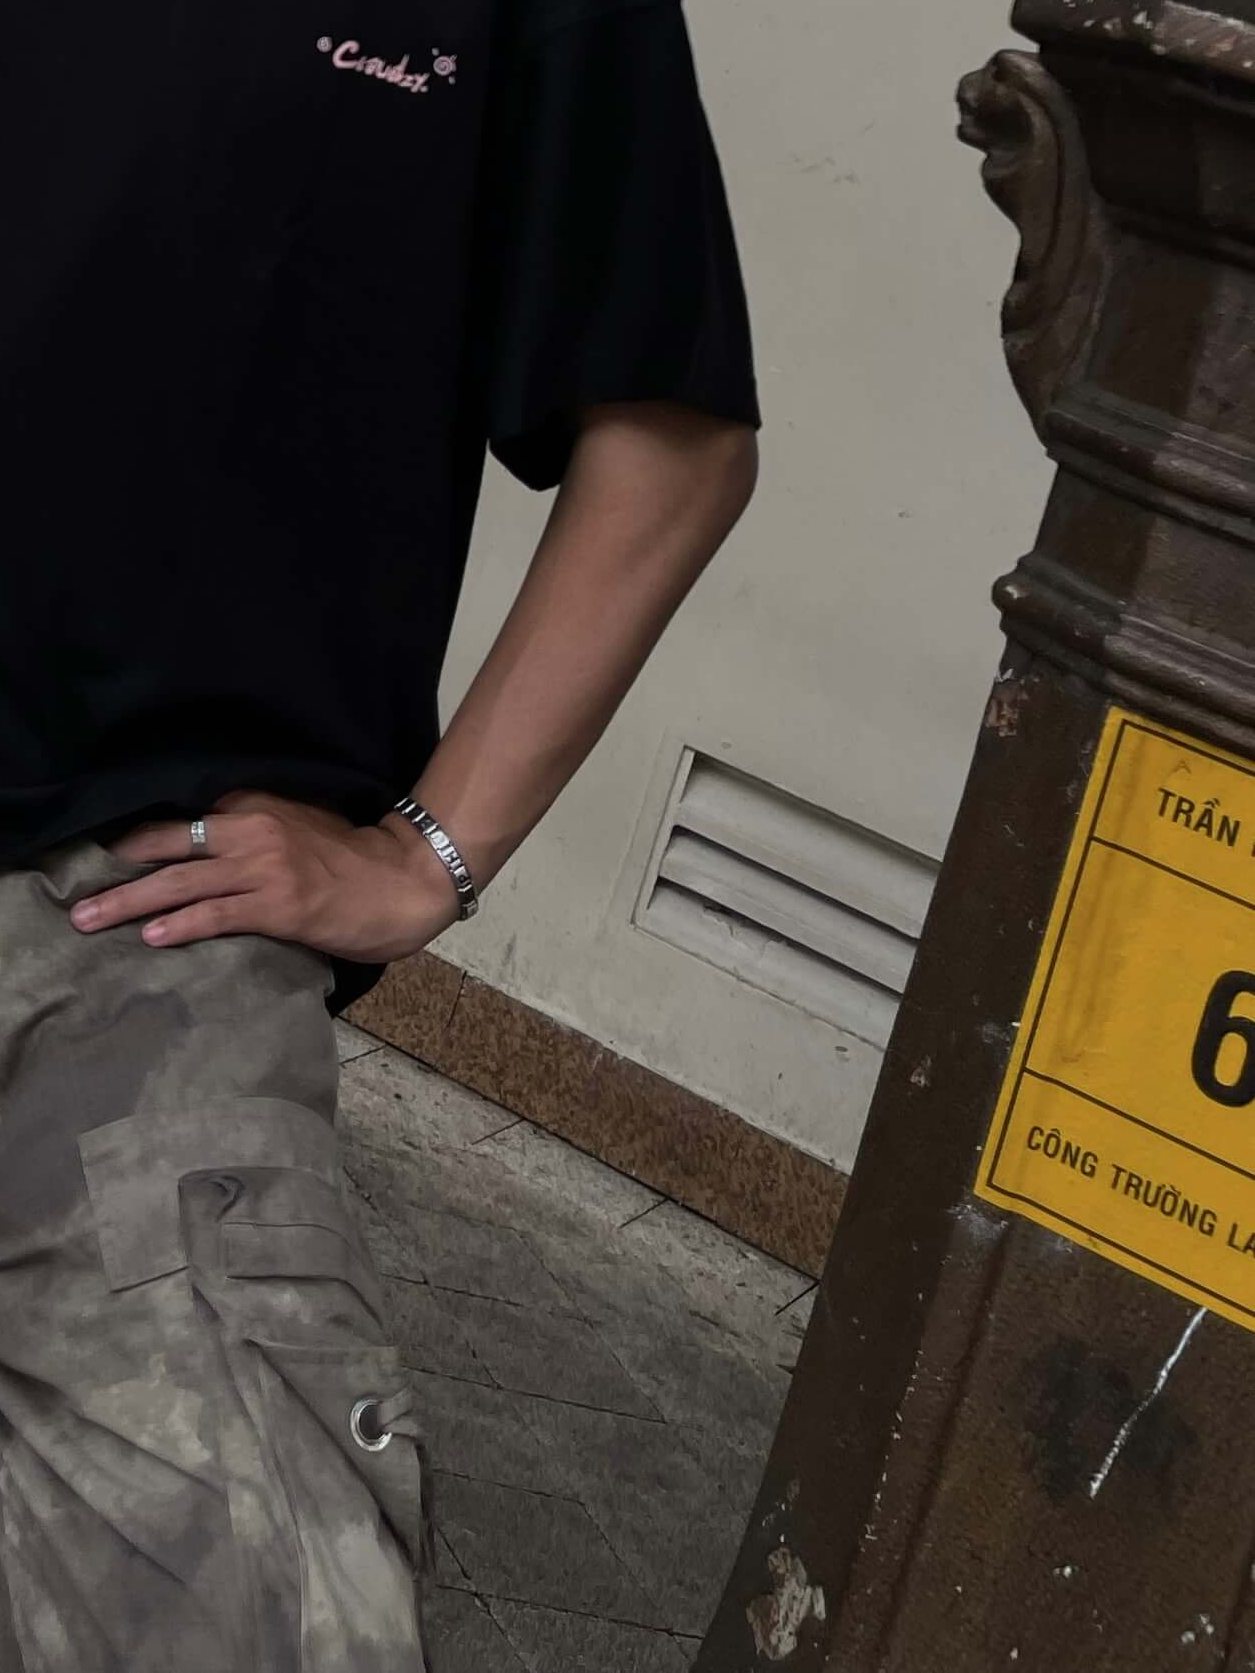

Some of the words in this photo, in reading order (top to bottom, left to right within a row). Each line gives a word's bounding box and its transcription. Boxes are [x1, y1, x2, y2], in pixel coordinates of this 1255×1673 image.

[1157, 787, 1241, 847] TRẦN
[1026, 1125, 1098, 1178] CÔNG
[1110, 1163, 1218, 1237] TRƯỜNG
